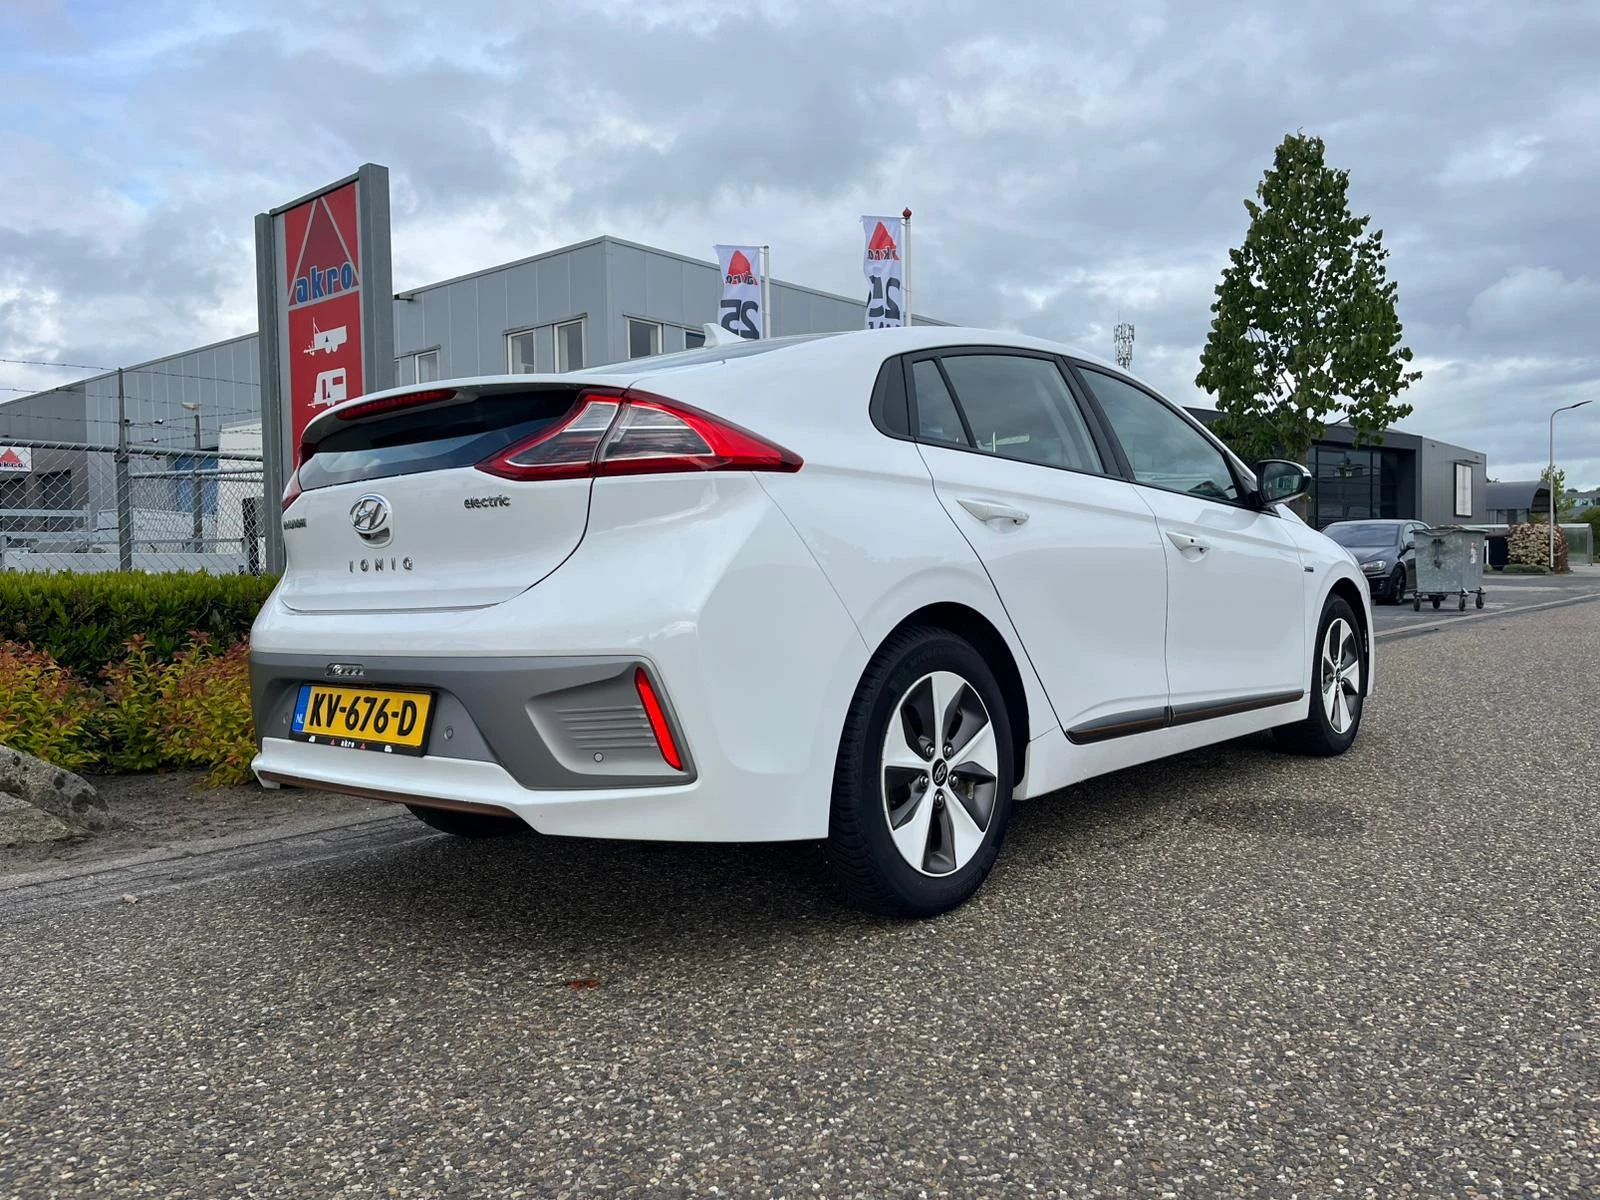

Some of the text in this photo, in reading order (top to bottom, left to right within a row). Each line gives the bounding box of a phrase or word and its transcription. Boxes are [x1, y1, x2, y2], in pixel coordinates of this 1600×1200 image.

[296, 261, 354, 304] akro
[464, 494, 511, 509] electric
[349, 557, 413, 573] IONIQ
[295, 713, 304, 724] NL
[309, 693, 417, 736] KV-676-D
[340, 739, 355, 748] akro
